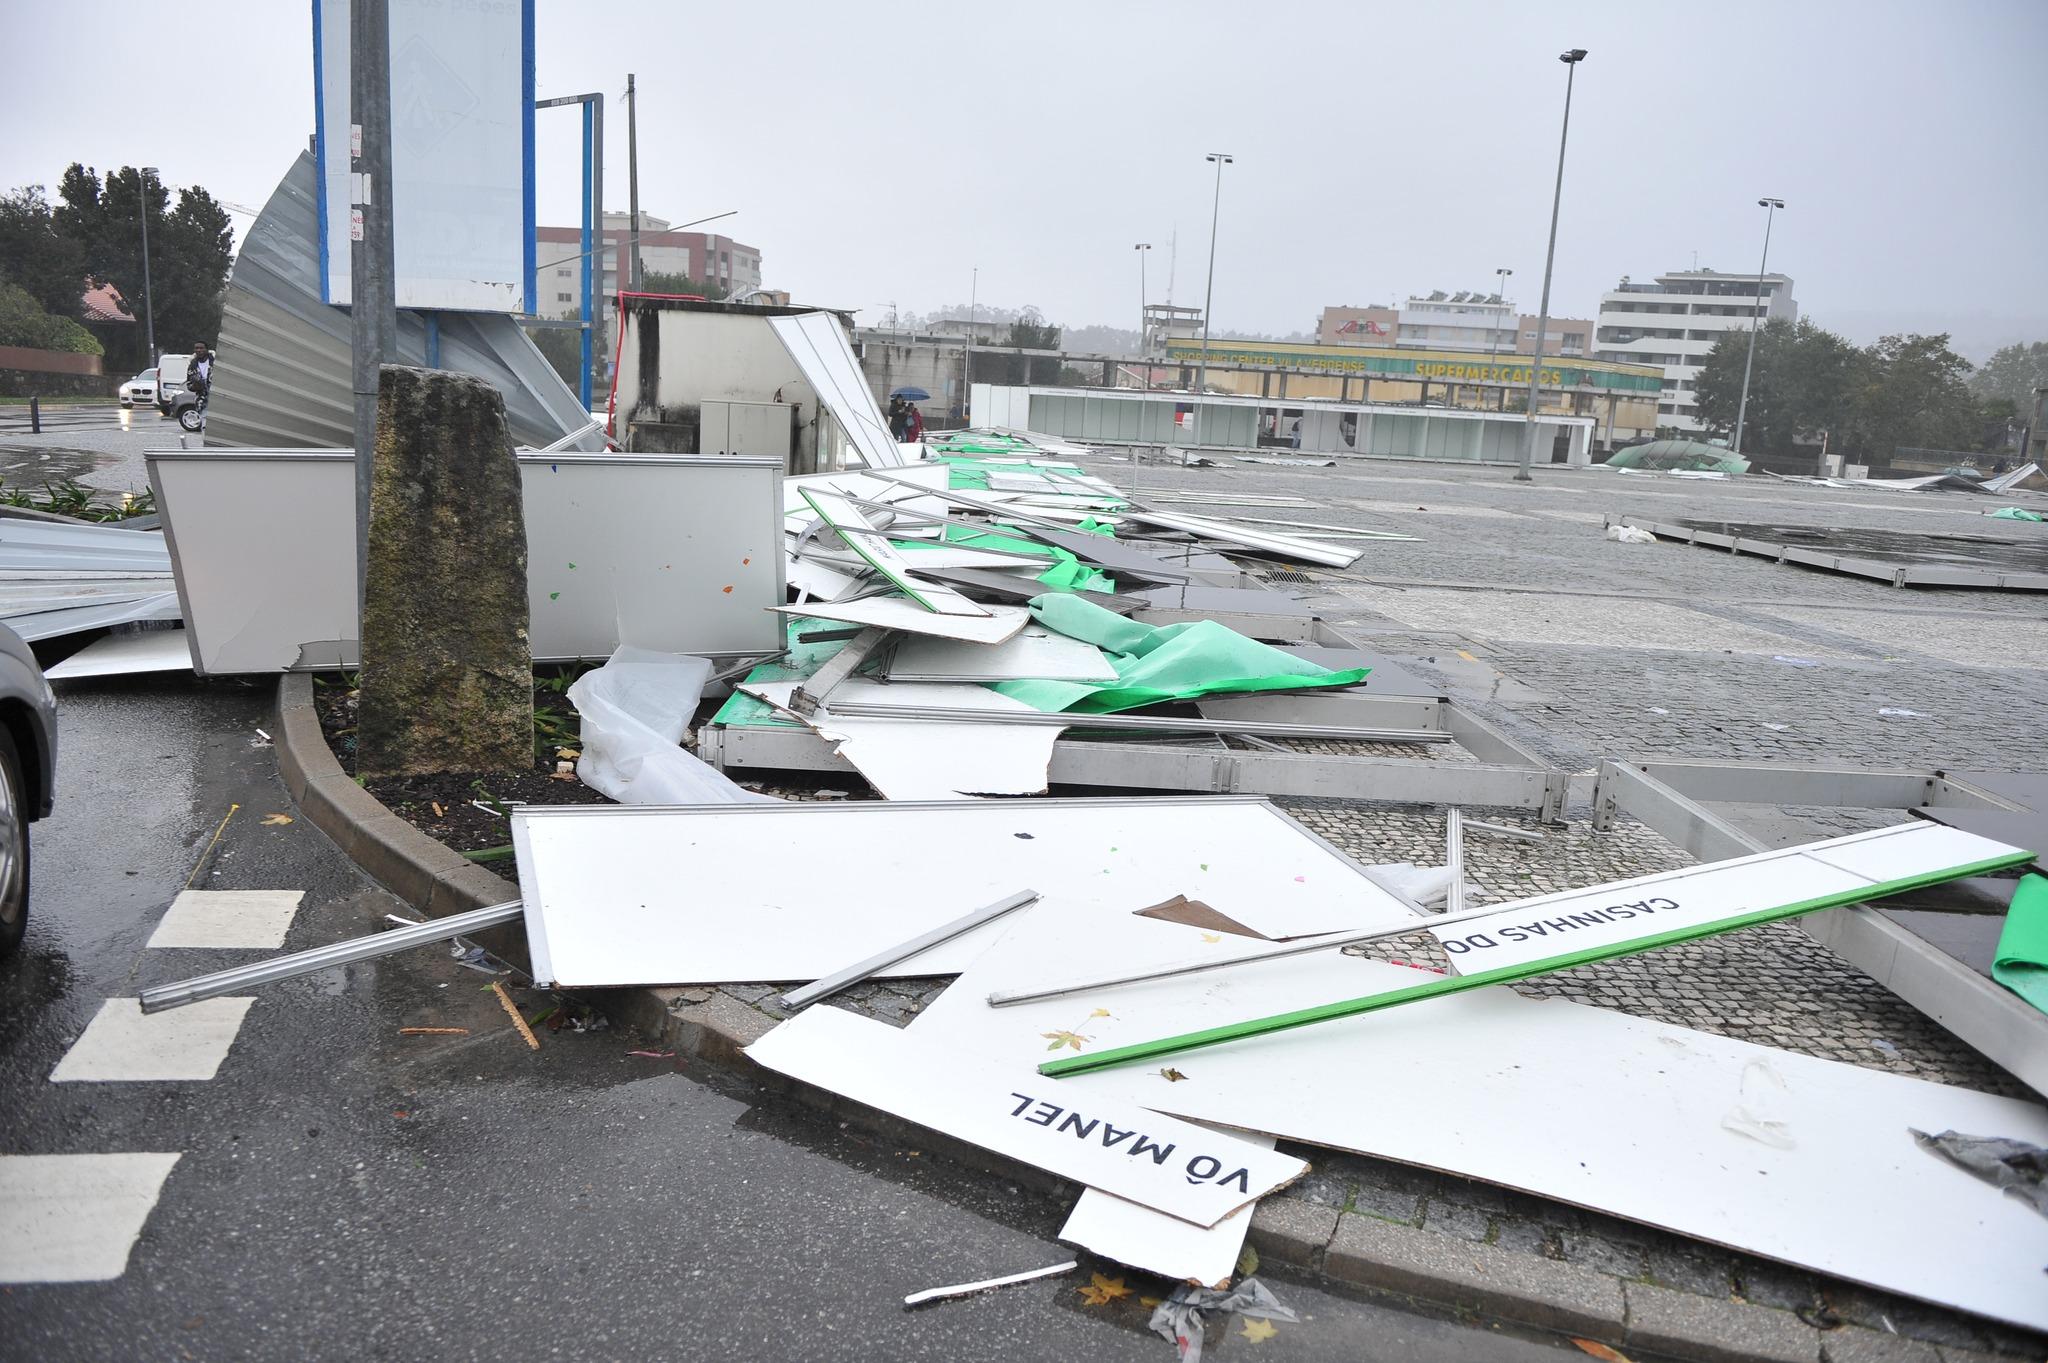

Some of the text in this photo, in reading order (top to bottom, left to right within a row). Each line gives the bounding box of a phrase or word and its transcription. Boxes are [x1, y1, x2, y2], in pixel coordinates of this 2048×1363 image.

[1416, 363, 1560, 384] SUPERMERCADOS
[1442, 897, 1681, 954] CASINHAS DO
[1010, 1092, 1249, 1194] VÔ MANEL
